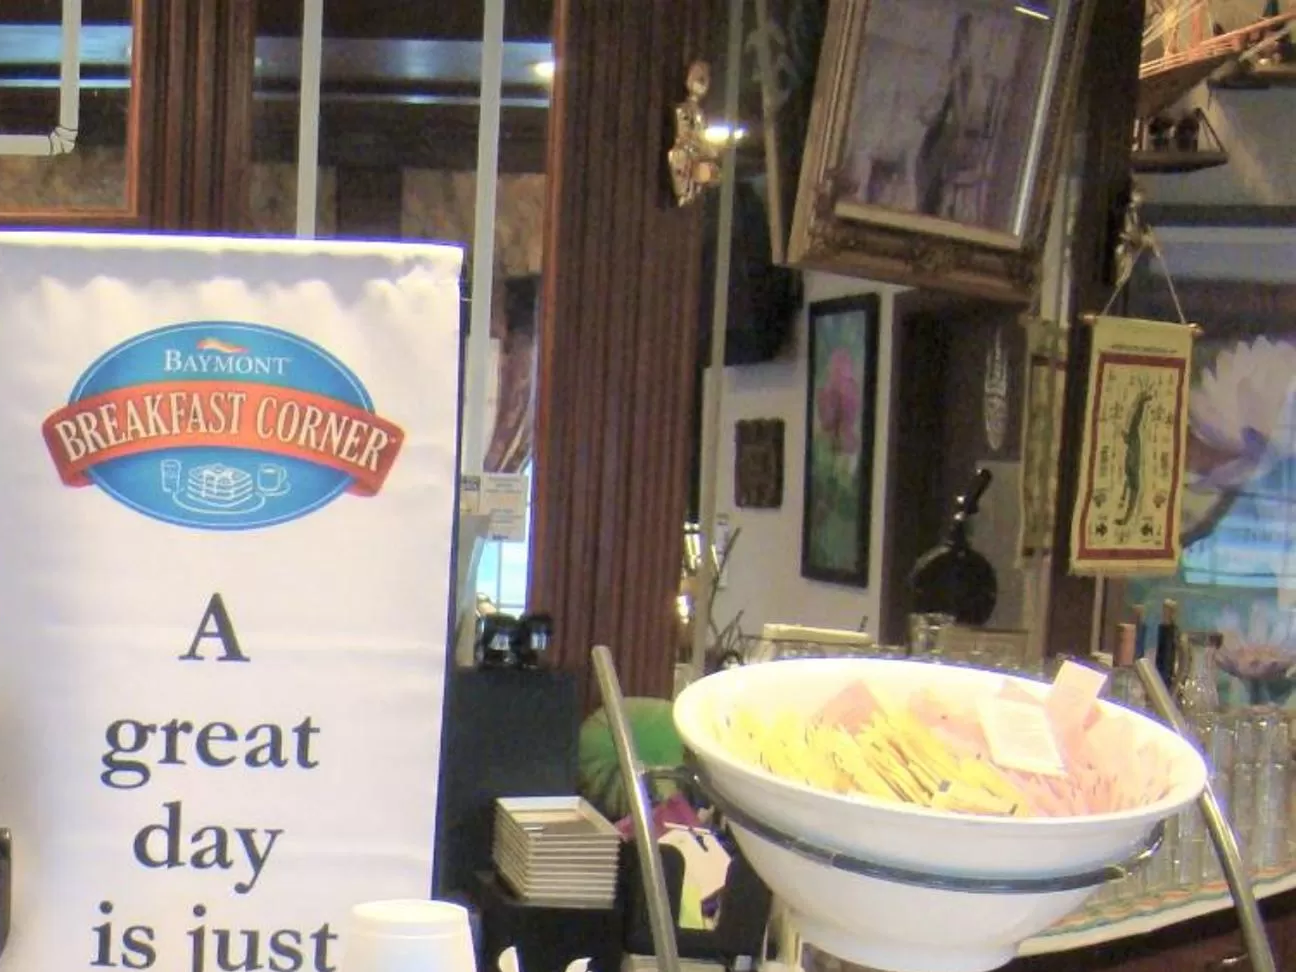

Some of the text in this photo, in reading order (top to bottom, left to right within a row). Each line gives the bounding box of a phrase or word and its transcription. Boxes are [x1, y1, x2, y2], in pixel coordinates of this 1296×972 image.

[163, 350, 287, 376] BAYMONT
[55, 391, 388, 472] BREAKFAST CORNER
[178, 592, 251, 662] A
[100, 716, 321, 789] great
[133, 800, 284, 894] day
[90, 900, 156, 969] is
